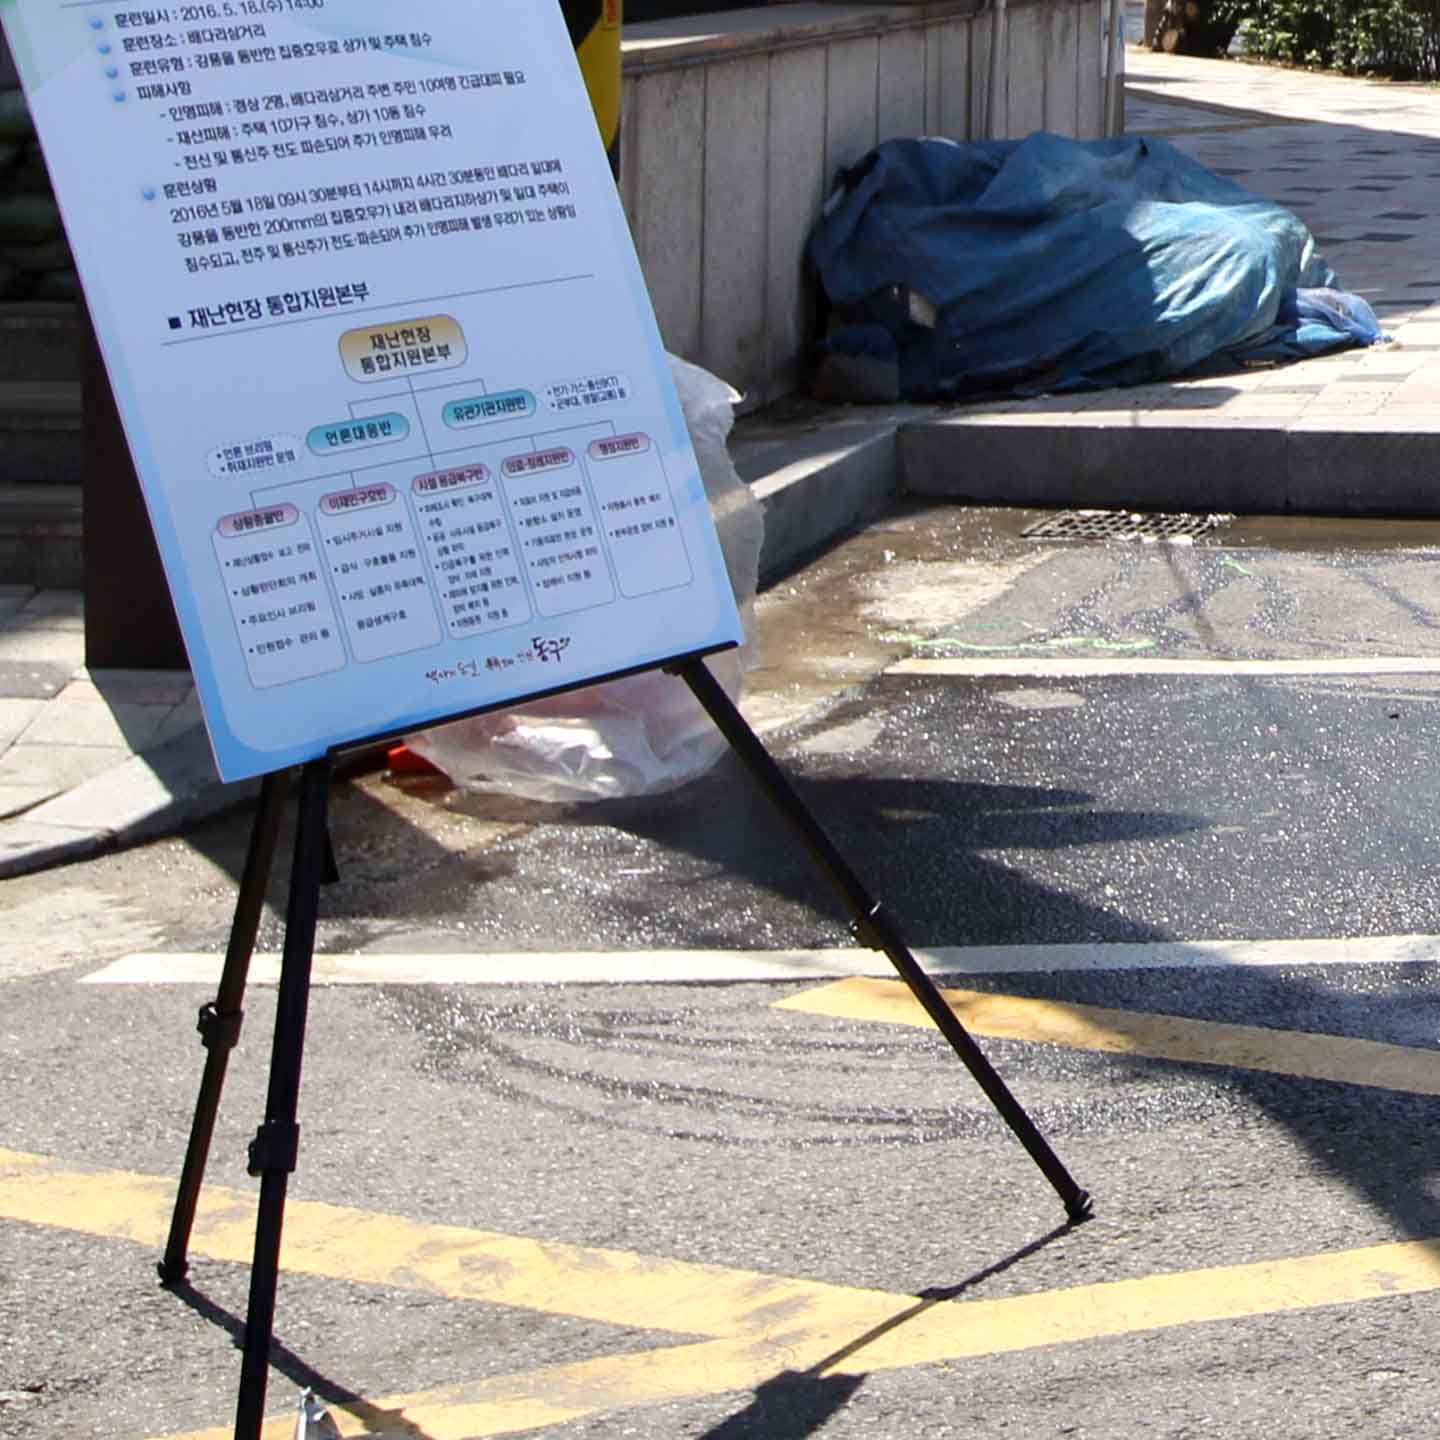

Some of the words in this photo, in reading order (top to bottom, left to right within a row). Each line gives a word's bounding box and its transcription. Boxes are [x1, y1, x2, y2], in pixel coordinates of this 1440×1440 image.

[114, 9, 170, 28] 훈련일시
[180, 4, 222, 22] 2016.
[122, 33, 178, 53] 훈련장소
[187, 23, 266, 45] 배다리삼거리
[343, 36, 367, 54] 상가
[384, 33, 408, 50] 주택
[409, 32, 433, 48] 침수
[136, 80, 192, 100] 피해사항
[169, 101, 224, 122] 인명피해
[290, 85, 365, 108] 배다리삼거리
[394, 80, 417, 96] 주민
[176, 124, 231, 145] 재산피해
[241, 119, 267, 137] 주택
[347, 109, 371, 126] 상가
[403, 103, 427, 119] 침수
[380, 126, 427, 146] 인명피해
[170, 205, 219, 224] 2016년
[278, 190, 307, 207] 09시
[188, 297, 263, 329] 재난현장
[265, 280, 370, 317] 통합지원본부
[368, 325, 432, 350] 재난현장
[359, 343, 452, 374] 통합지원본부
[324, 420, 393, 447] 언론대응반
